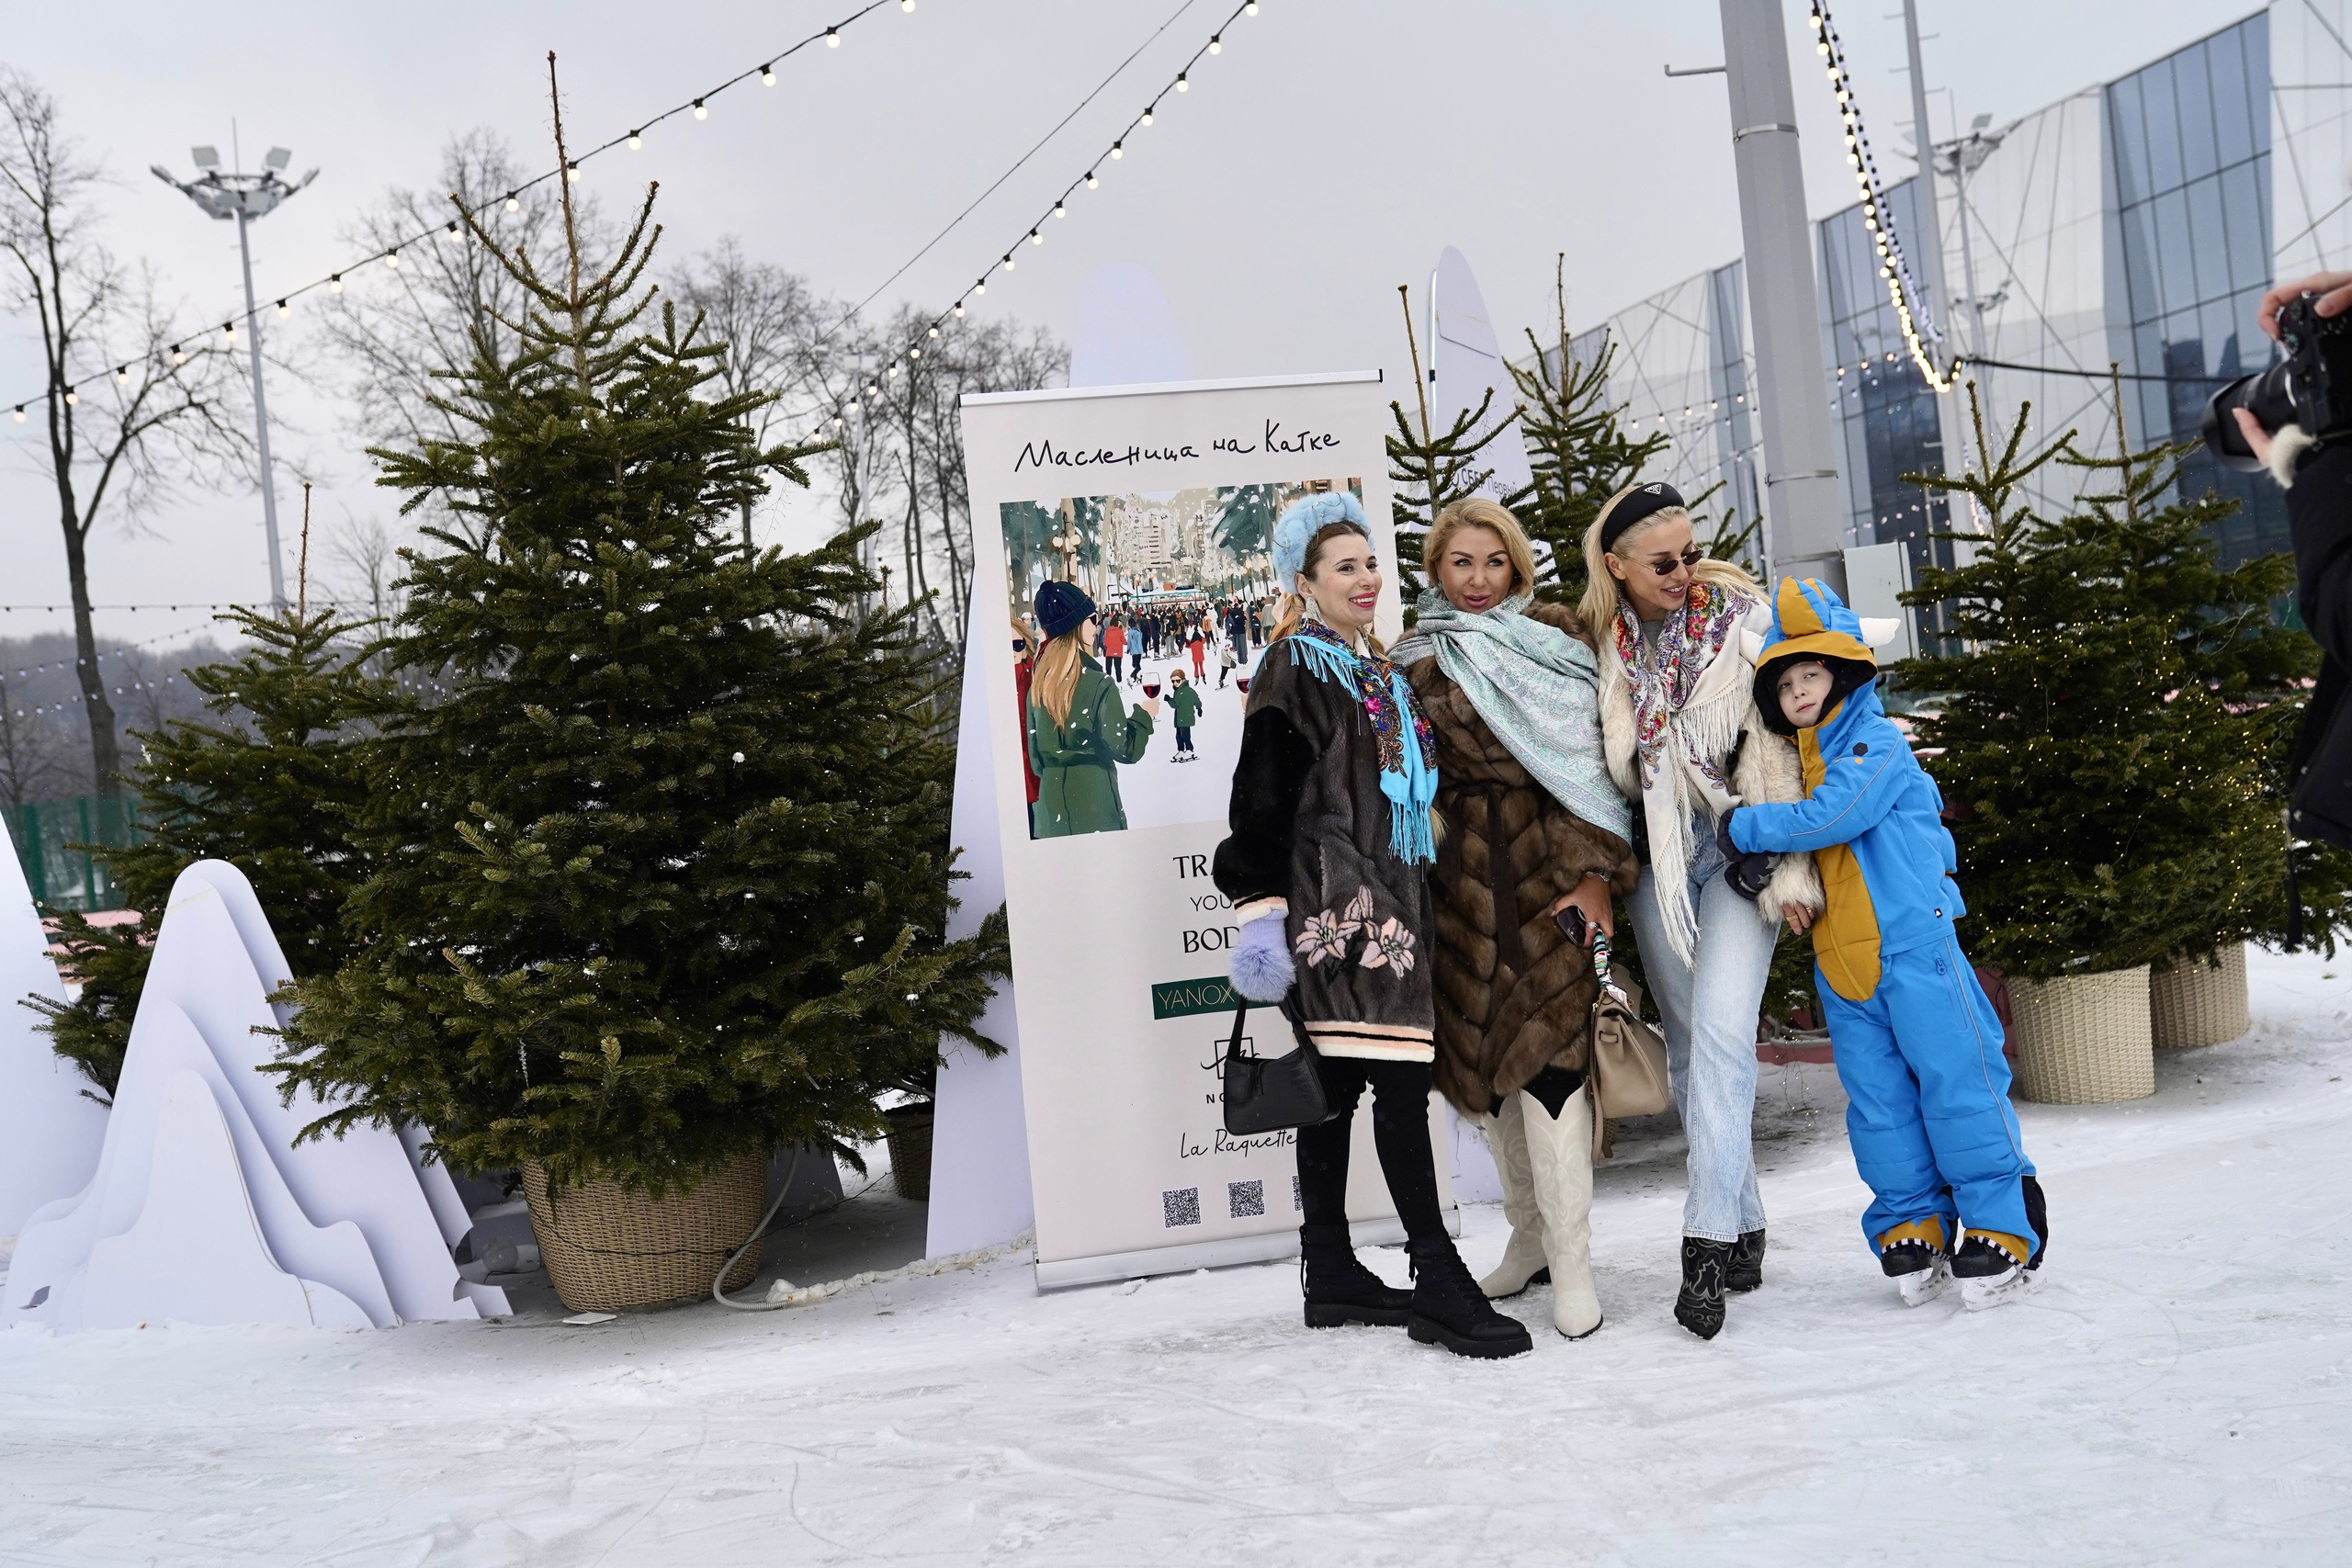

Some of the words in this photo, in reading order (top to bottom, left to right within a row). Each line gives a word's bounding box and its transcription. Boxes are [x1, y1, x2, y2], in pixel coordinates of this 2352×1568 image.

[1014, 439, 1199, 473] Масленица
[1213, 438, 1256, 454] на
[1265, 418, 1340, 453] Катке
[1172, 854, 1214, 879] TR
[1181, 1133, 1209, 1158] La
[1214, 1129, 1297, 1158] Raquette
